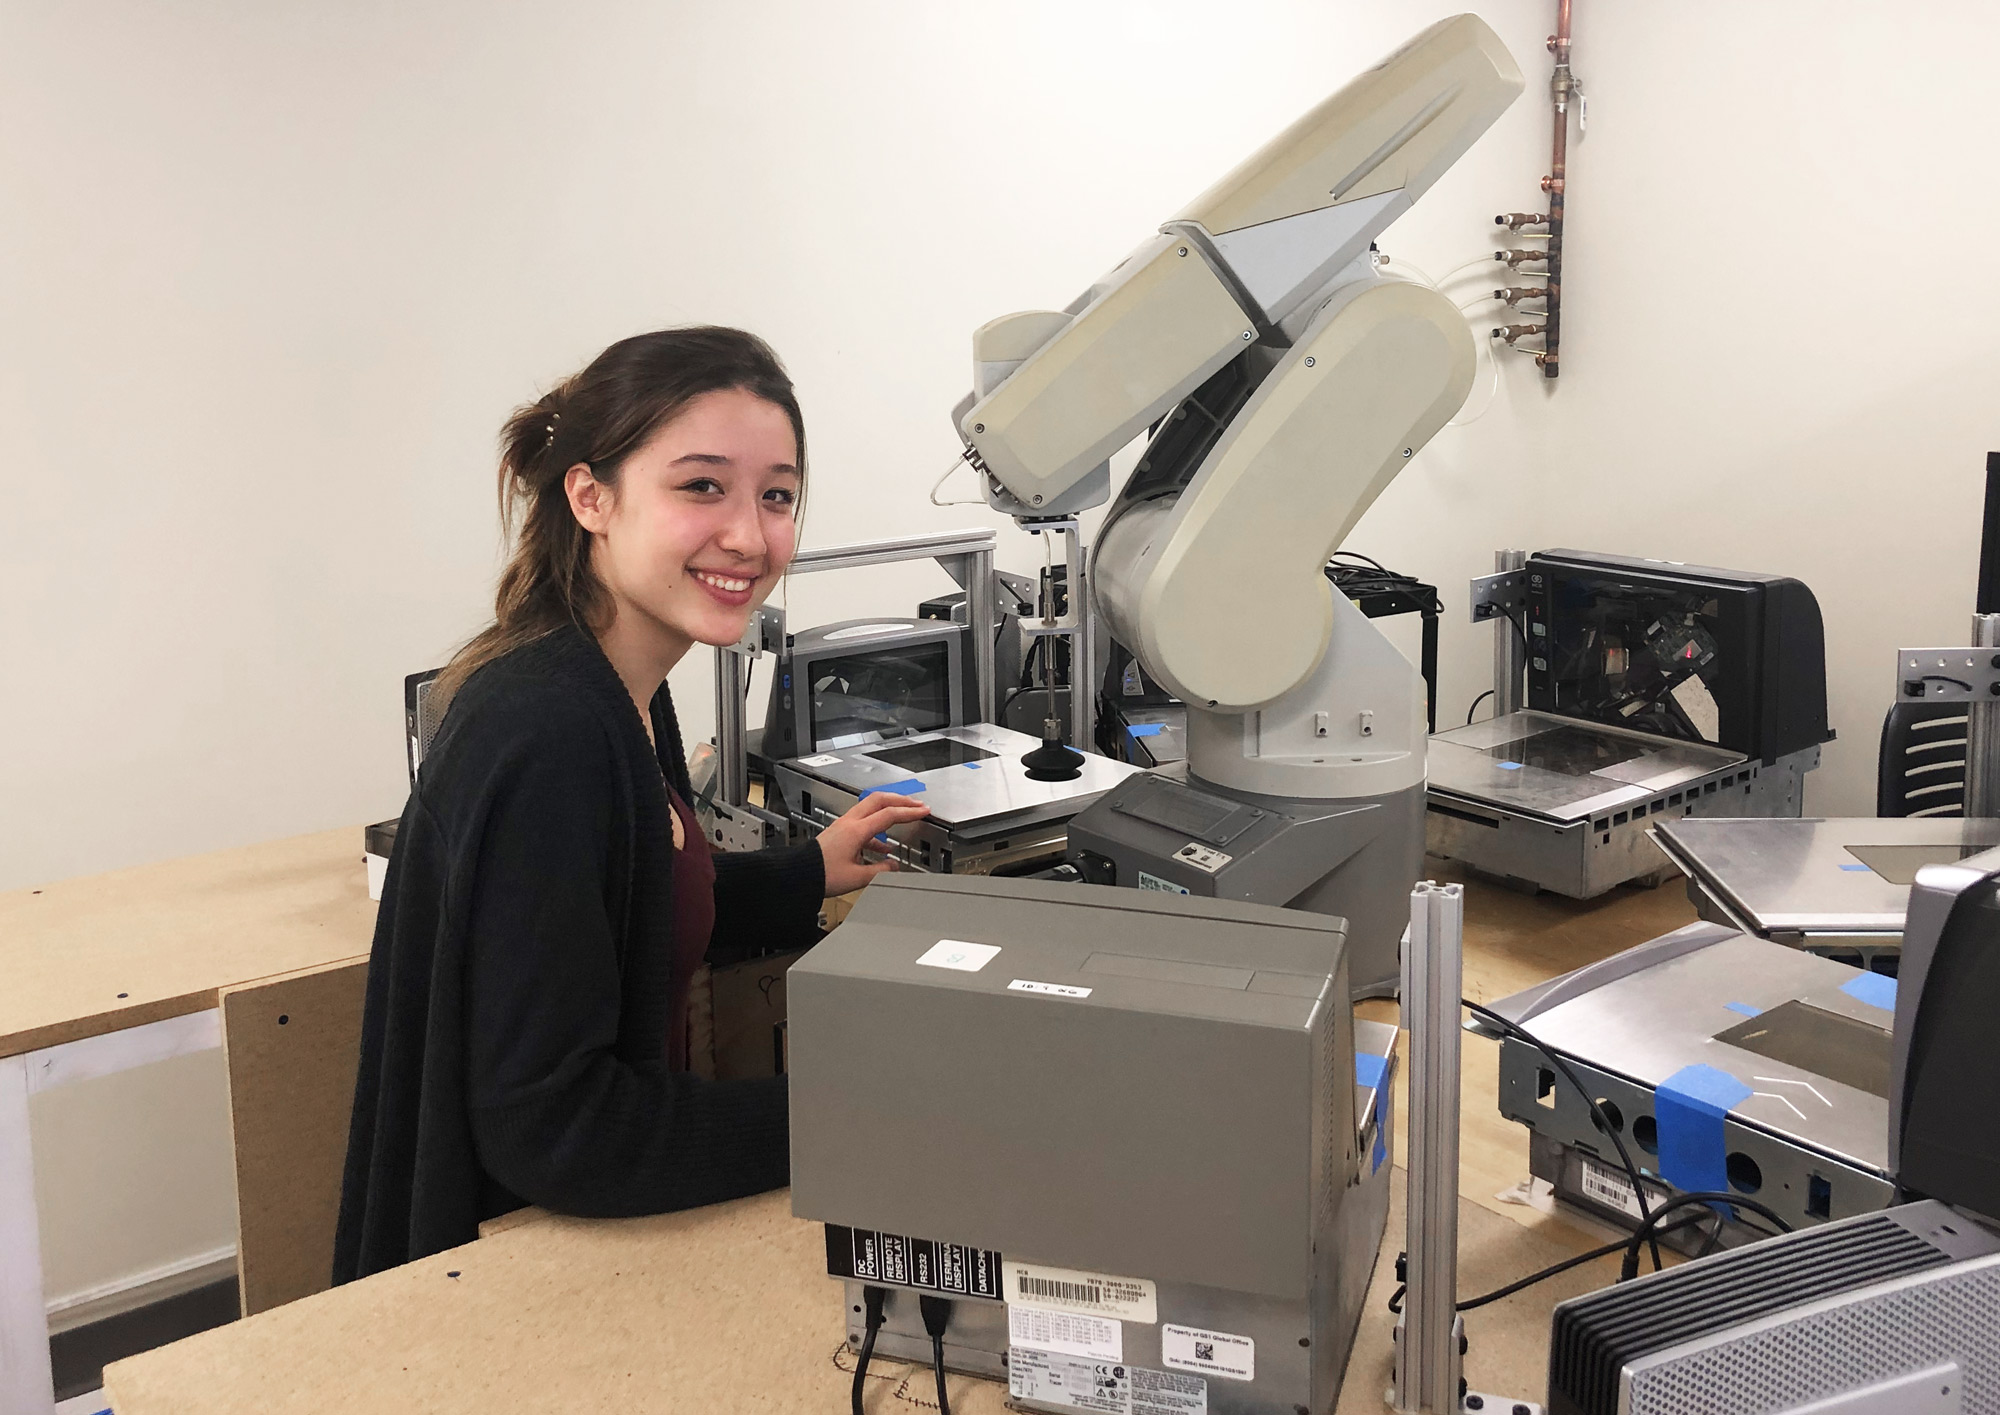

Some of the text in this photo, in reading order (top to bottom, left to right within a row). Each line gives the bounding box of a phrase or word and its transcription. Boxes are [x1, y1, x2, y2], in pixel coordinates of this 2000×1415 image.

[857, 1259, 866, 1274] DC
[865, 1239, 875, 1275] POWER
[885, 1237, 895, 1278] REMOTE
[894, 1238, 904, 1279] DISPLAY
[919, 1253, 928, 1283] RS232
[951, 1247, 962, 1288] DISPLAY
[1167, 1327, 1191, 1337] Property
[1212, 1335, 1231, 1343] Global
[1232, 1338, 1249, 1346] Office
